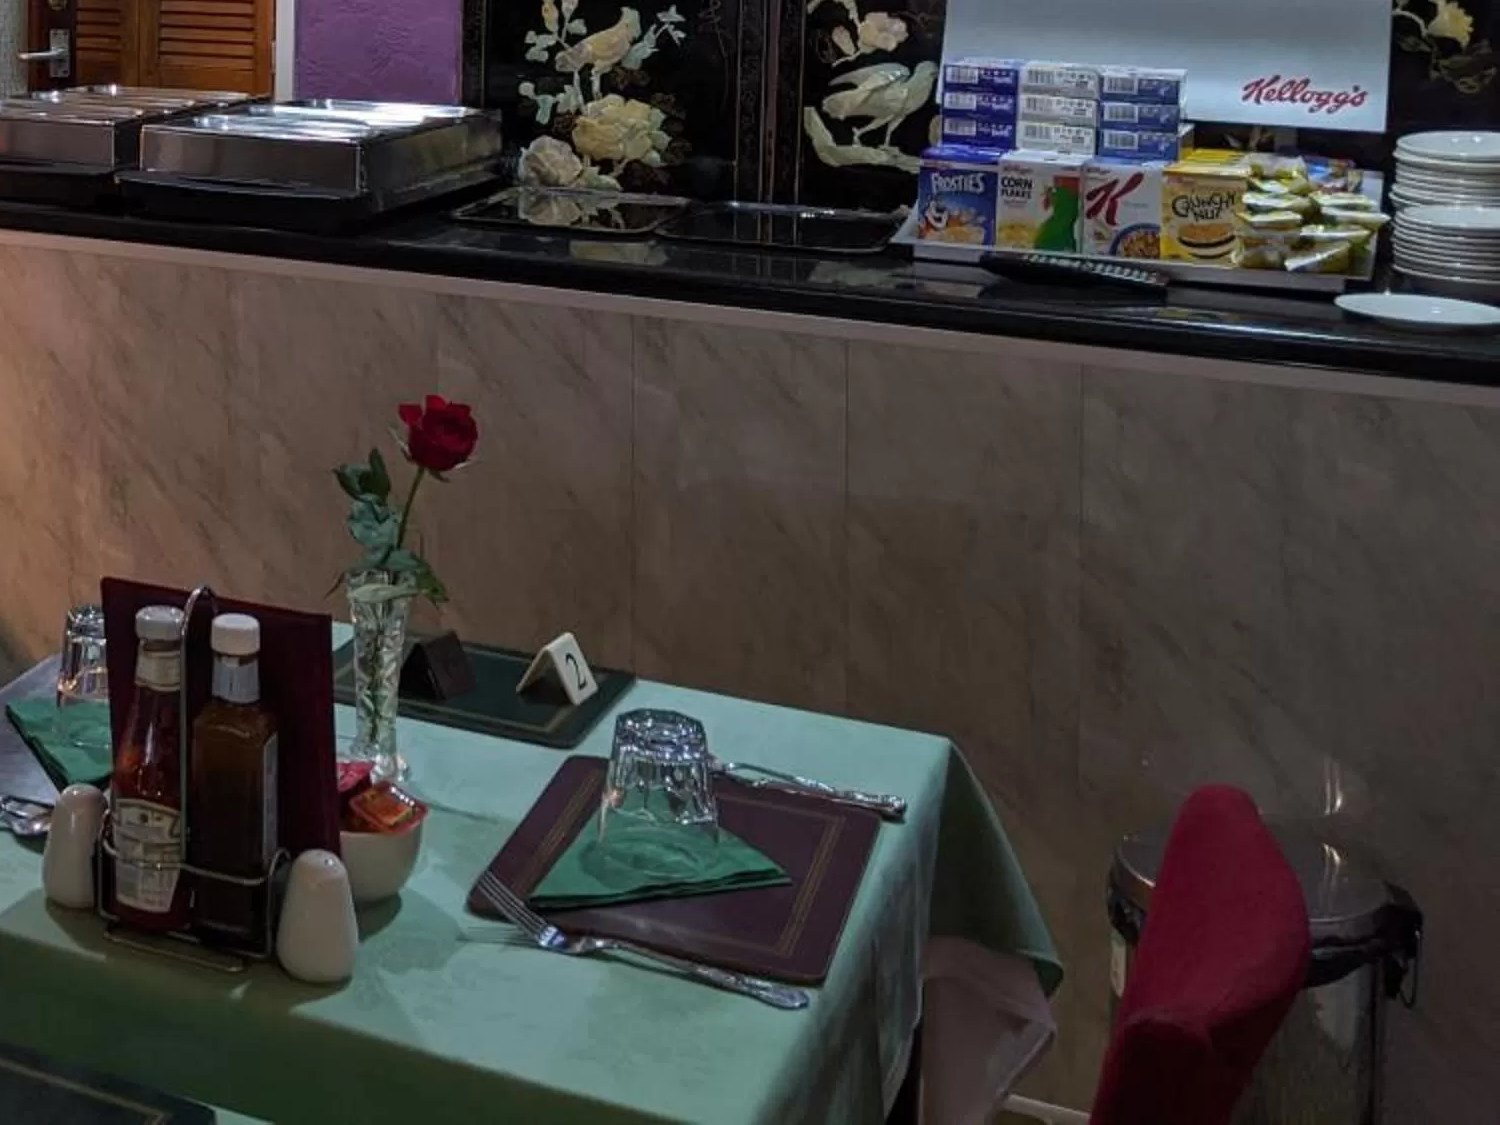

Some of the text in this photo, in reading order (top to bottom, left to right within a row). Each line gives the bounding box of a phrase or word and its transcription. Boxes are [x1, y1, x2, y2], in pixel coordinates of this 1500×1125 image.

[1242, 74, 1368, 114] Kellogg's
[1001, 176, 1033, 190] CORN
[1086, 171, 1144, 226] K
[565, 653, 587, 690] 2
